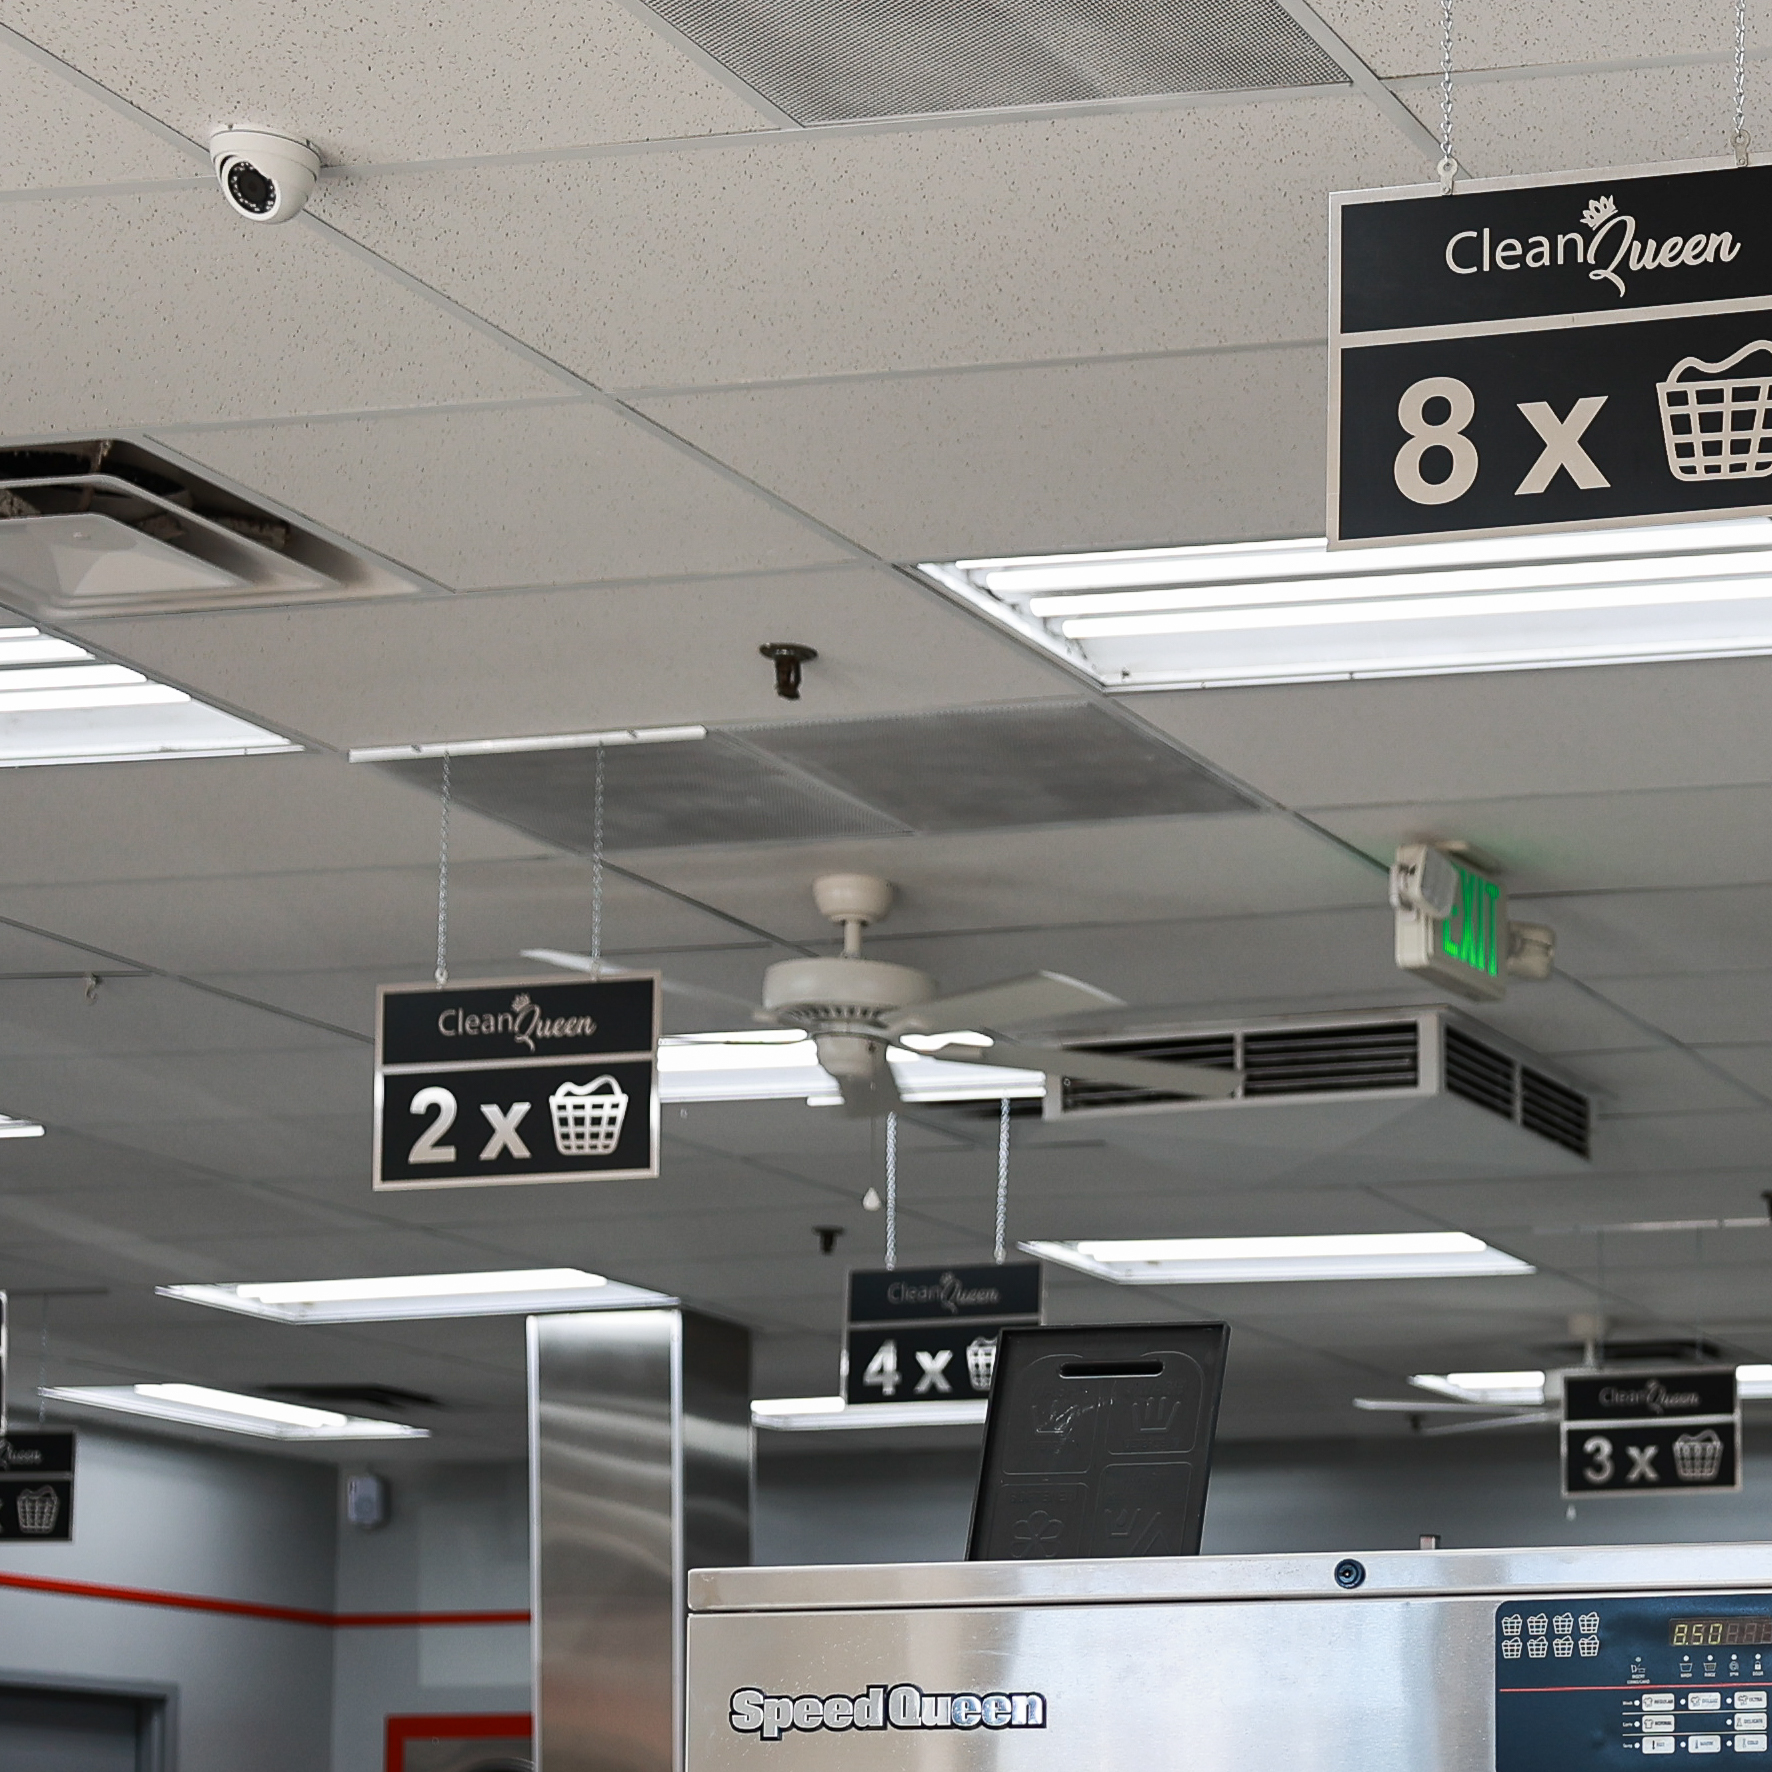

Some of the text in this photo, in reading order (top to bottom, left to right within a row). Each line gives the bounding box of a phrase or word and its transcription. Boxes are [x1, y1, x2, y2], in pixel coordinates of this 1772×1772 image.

[1394, 376, 1611, 505] 8 x
[408, 1086, 531, 1164] 2 x
[863, 1339, 953, 1396] 4 x
[1583, 1435, 1659, 1484] 3 x
[730, 1683, 1047, 1741] Speed Queen
